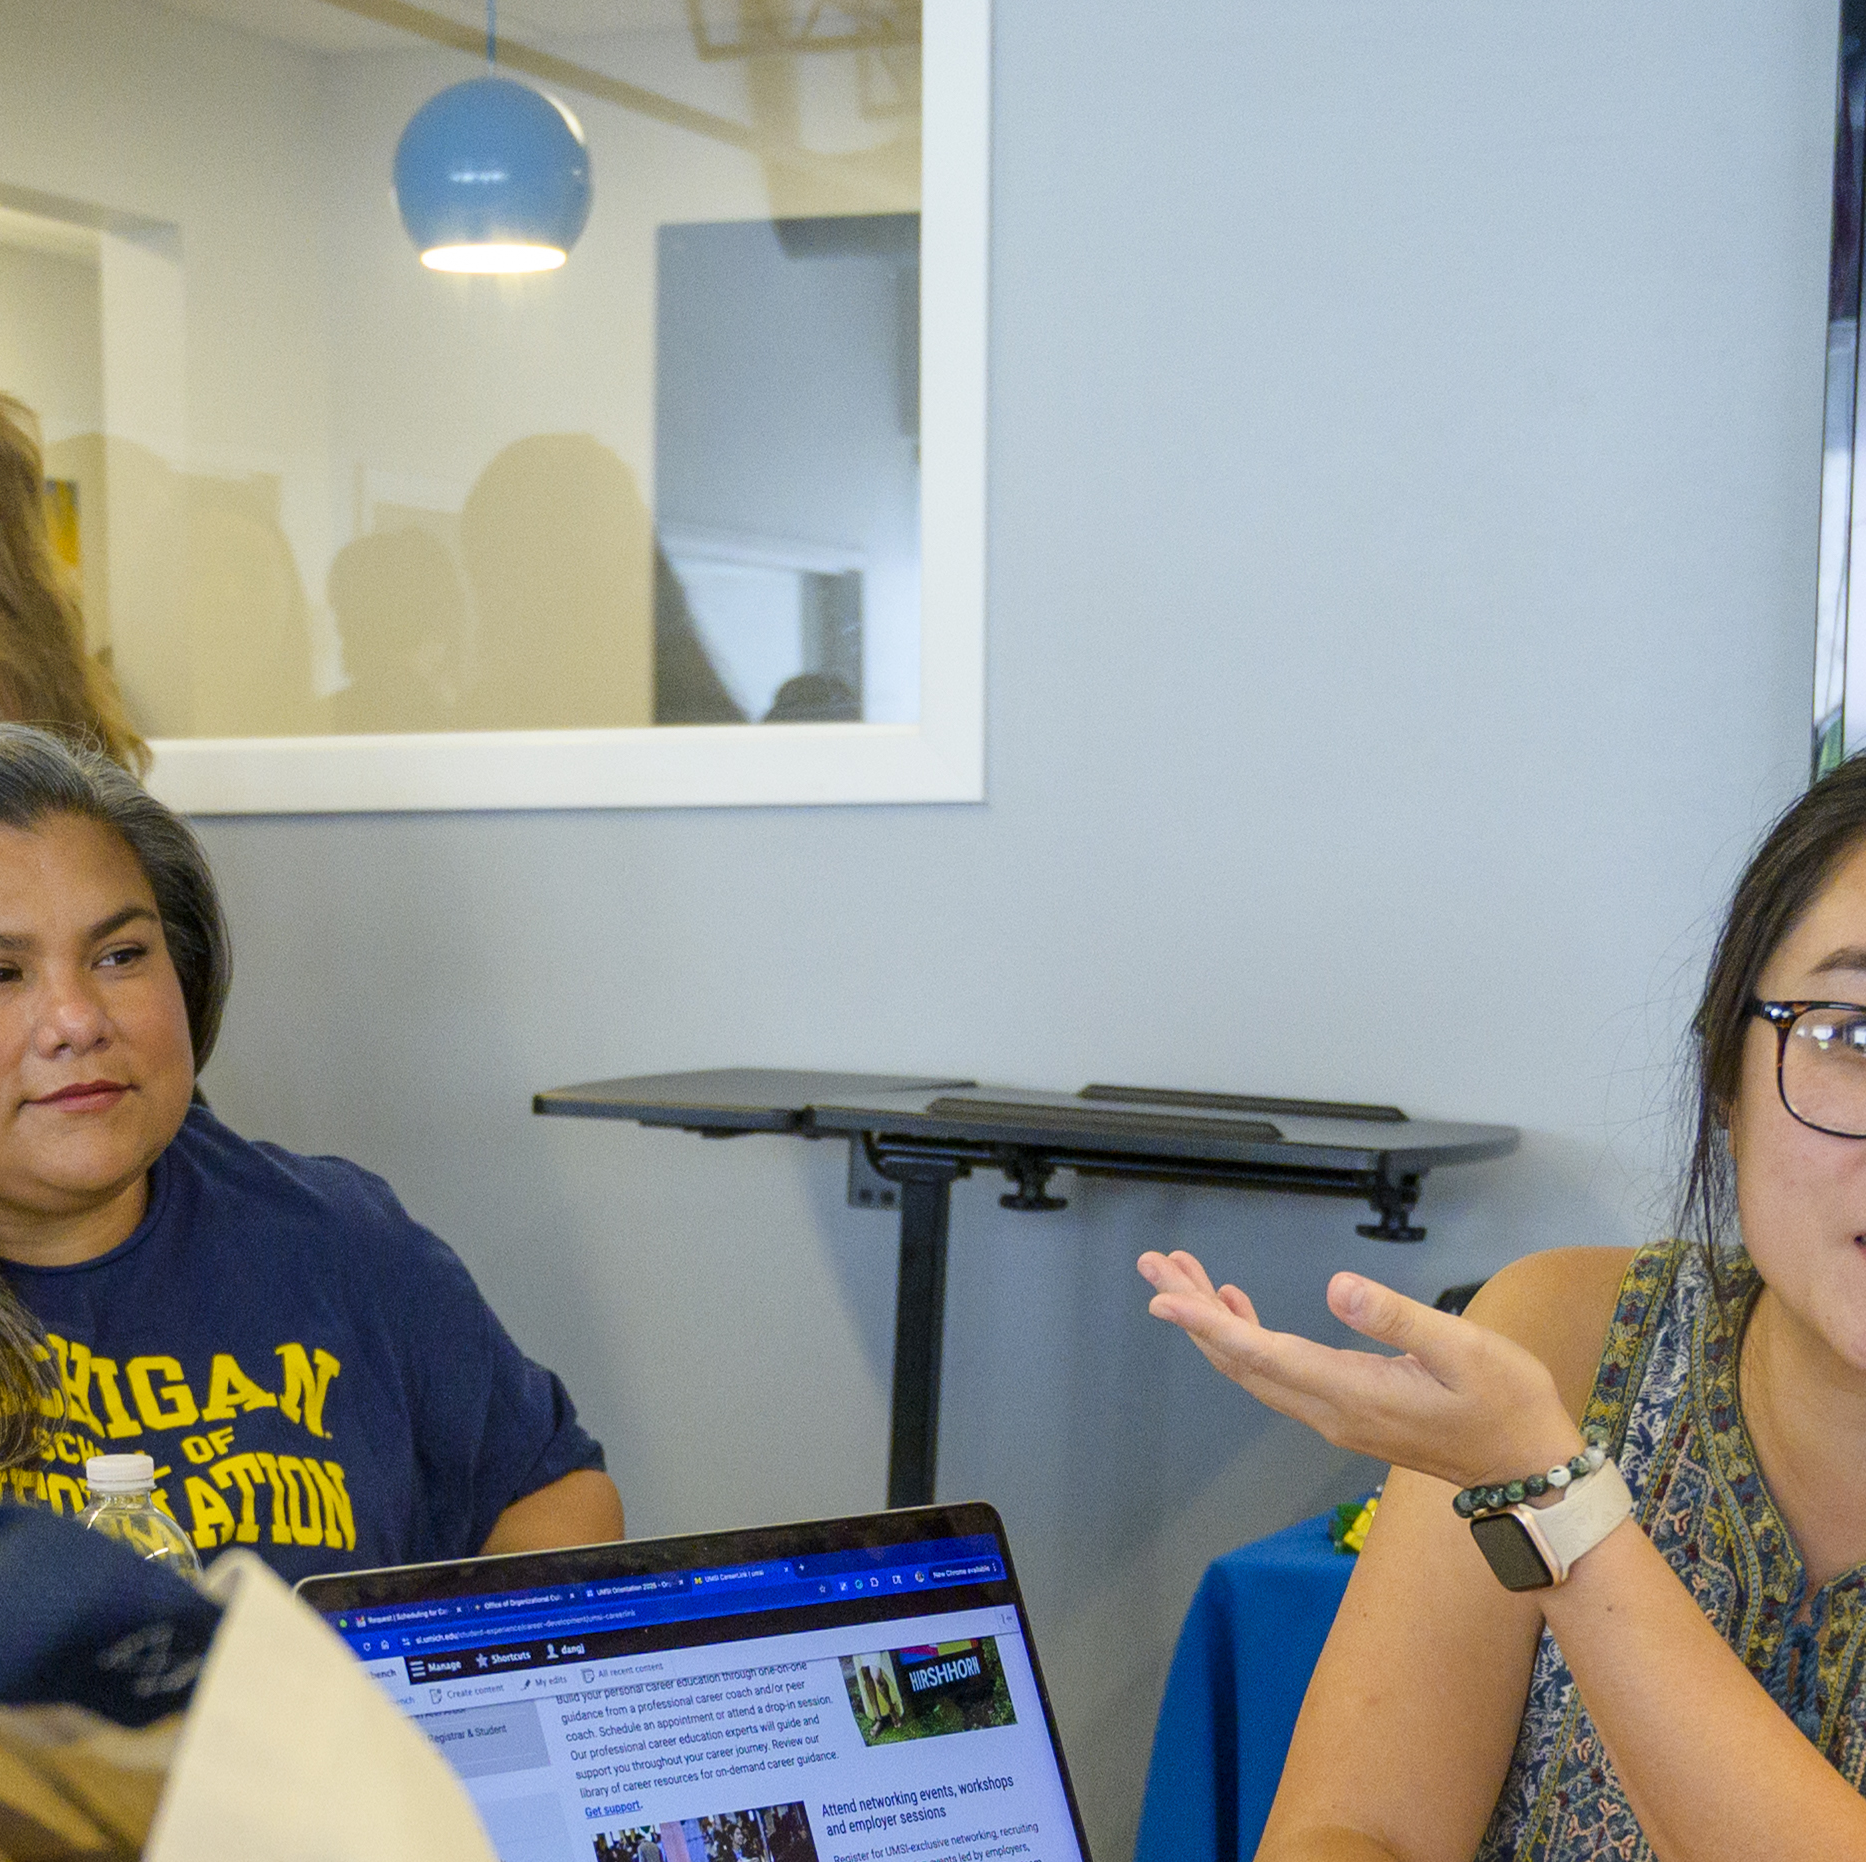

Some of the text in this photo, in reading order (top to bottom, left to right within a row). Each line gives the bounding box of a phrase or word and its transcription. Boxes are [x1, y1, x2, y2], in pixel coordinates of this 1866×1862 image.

[181, 1426, 236, 1463] OF
[611, 1584, 642, 1593] Orientation
[490, 1649, 532, 1664] Shortcuts
[560, 1643, 586, 1656] dangj
[426, 1659, 462, 1674] Manage
[534, 1676, 567, 1686] My edits
[598, 1662, 663, 1677] All recent content
[908, 1655, 981, 1693] HIRSHHORN
[446, 1689, 472, 1698] Create
[474, 1684, 503, 1694] content
[555, 1662, 808, 1704] Build your personal career education through one-on-one
[561, 1680, 804, 1725] guidance from a professional career coach and/or peer
[565, 1695, 832, 1741] coach. Schedule an appointment or attend a drop-in session.
[424, 1724, 506, 1746] Registrar & Student
[570, 1713, 819, 1760] Our professional career education experts will guide and
[575, 1734, 818, 1779] support you throughout your career journey. Review our
[579, 1751, 839, 1797] library of career resources for on-demand career guidance.
[584, 1800, 644, 1818] Get support.
[822, 1776, 1013, 1816] Attend networking events, workshops
[826, 1806, 946, 1836] and employer sessions
[870, 1848, 884, 1858] for
[883, 1839, 949, 1856] UMSI-exclusive
[950, 1830, 998, 1844] networking,
[999, 1823, 1038, 1835] recruiting
[958, 1851, 972, 1862] led
[972, 1850, 983, 1861] by
[985, 1843, 1030, 1857] employers,
